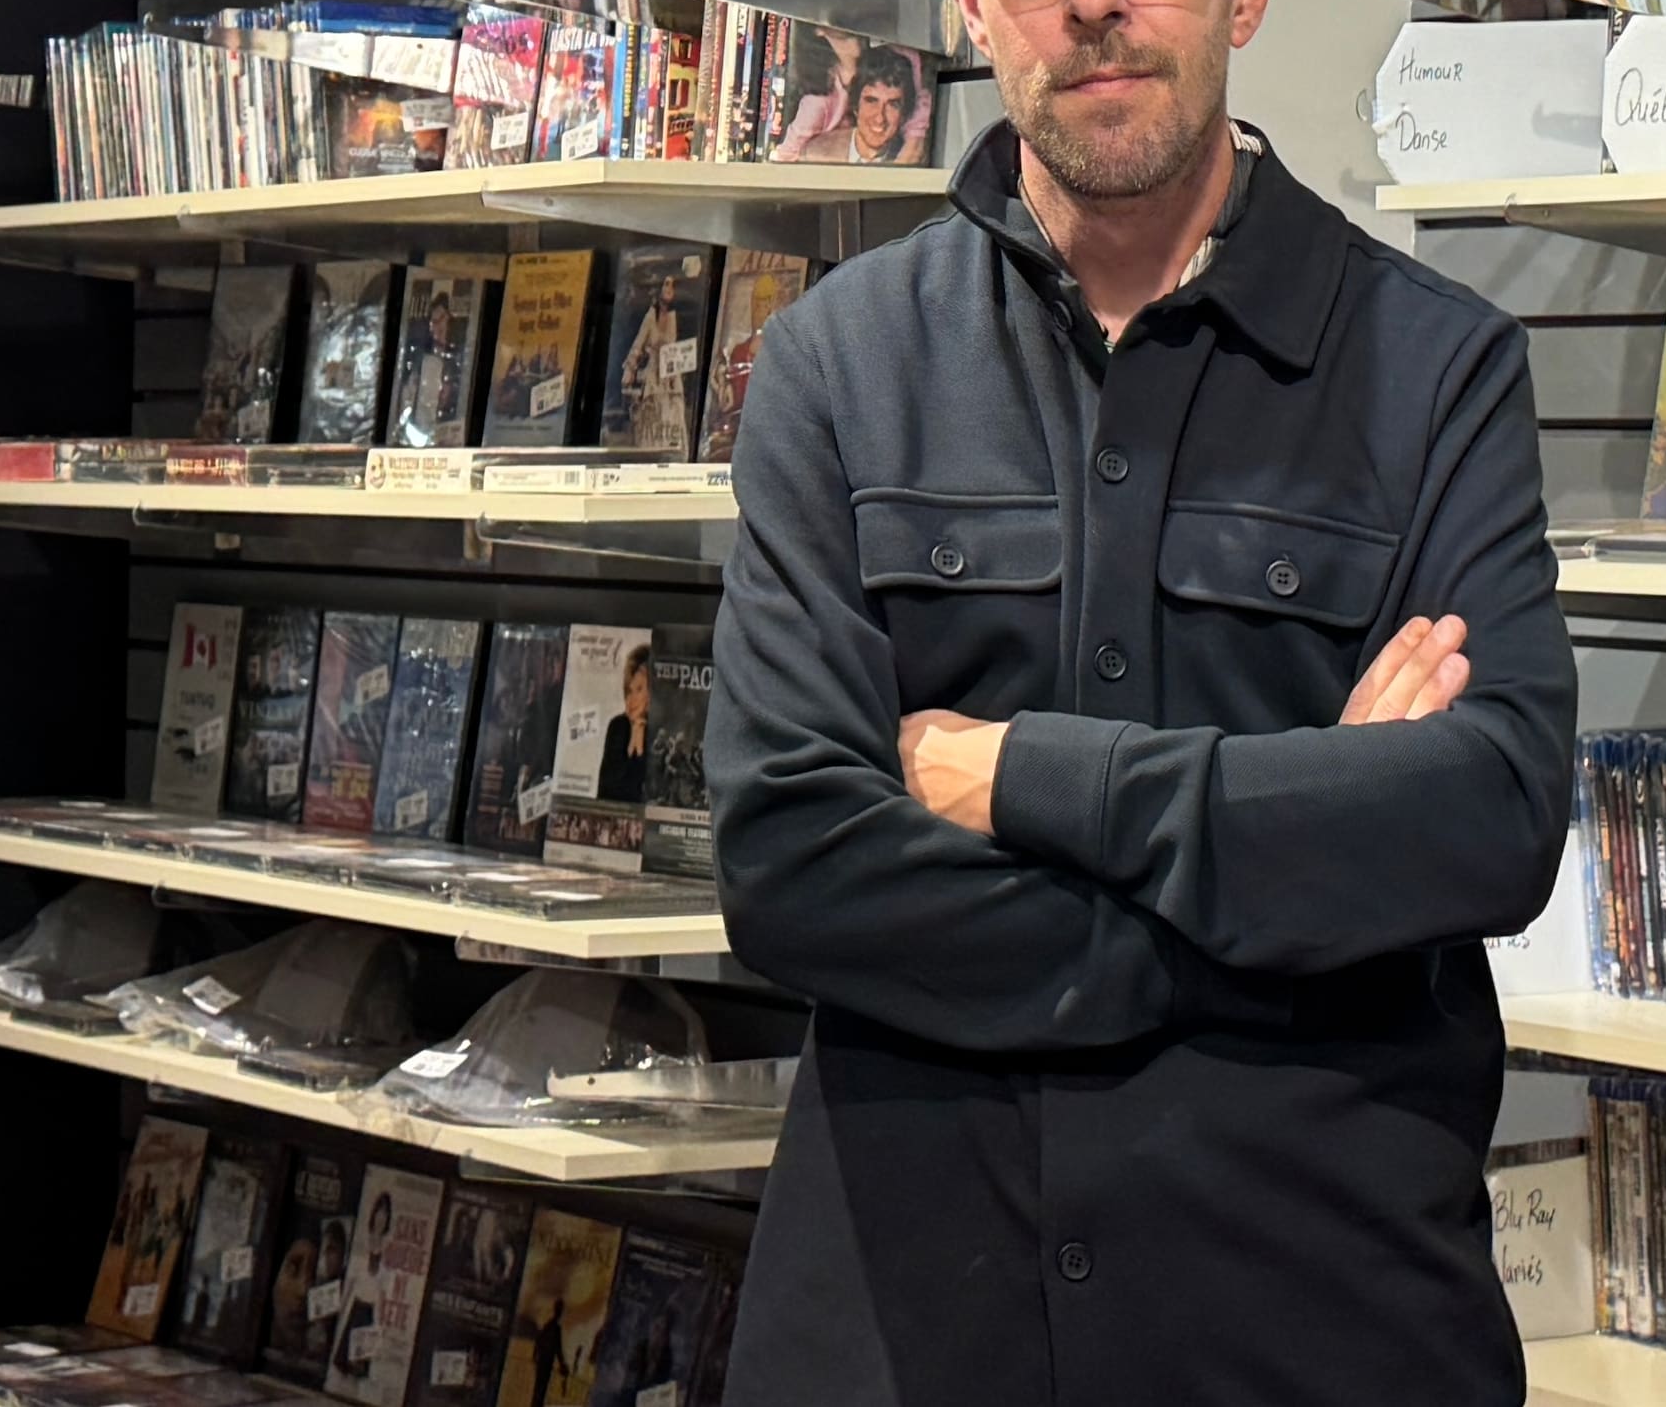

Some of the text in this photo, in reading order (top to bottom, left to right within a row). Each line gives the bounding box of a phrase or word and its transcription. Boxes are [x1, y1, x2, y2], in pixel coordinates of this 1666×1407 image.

[550, 25, 599, 52] HASTA LA
[1397, 110, 1448, 153] Danse
[654, 661, 715, 691] THE PAC
[1493, 1191, 1556, 1233] Blu Ray
